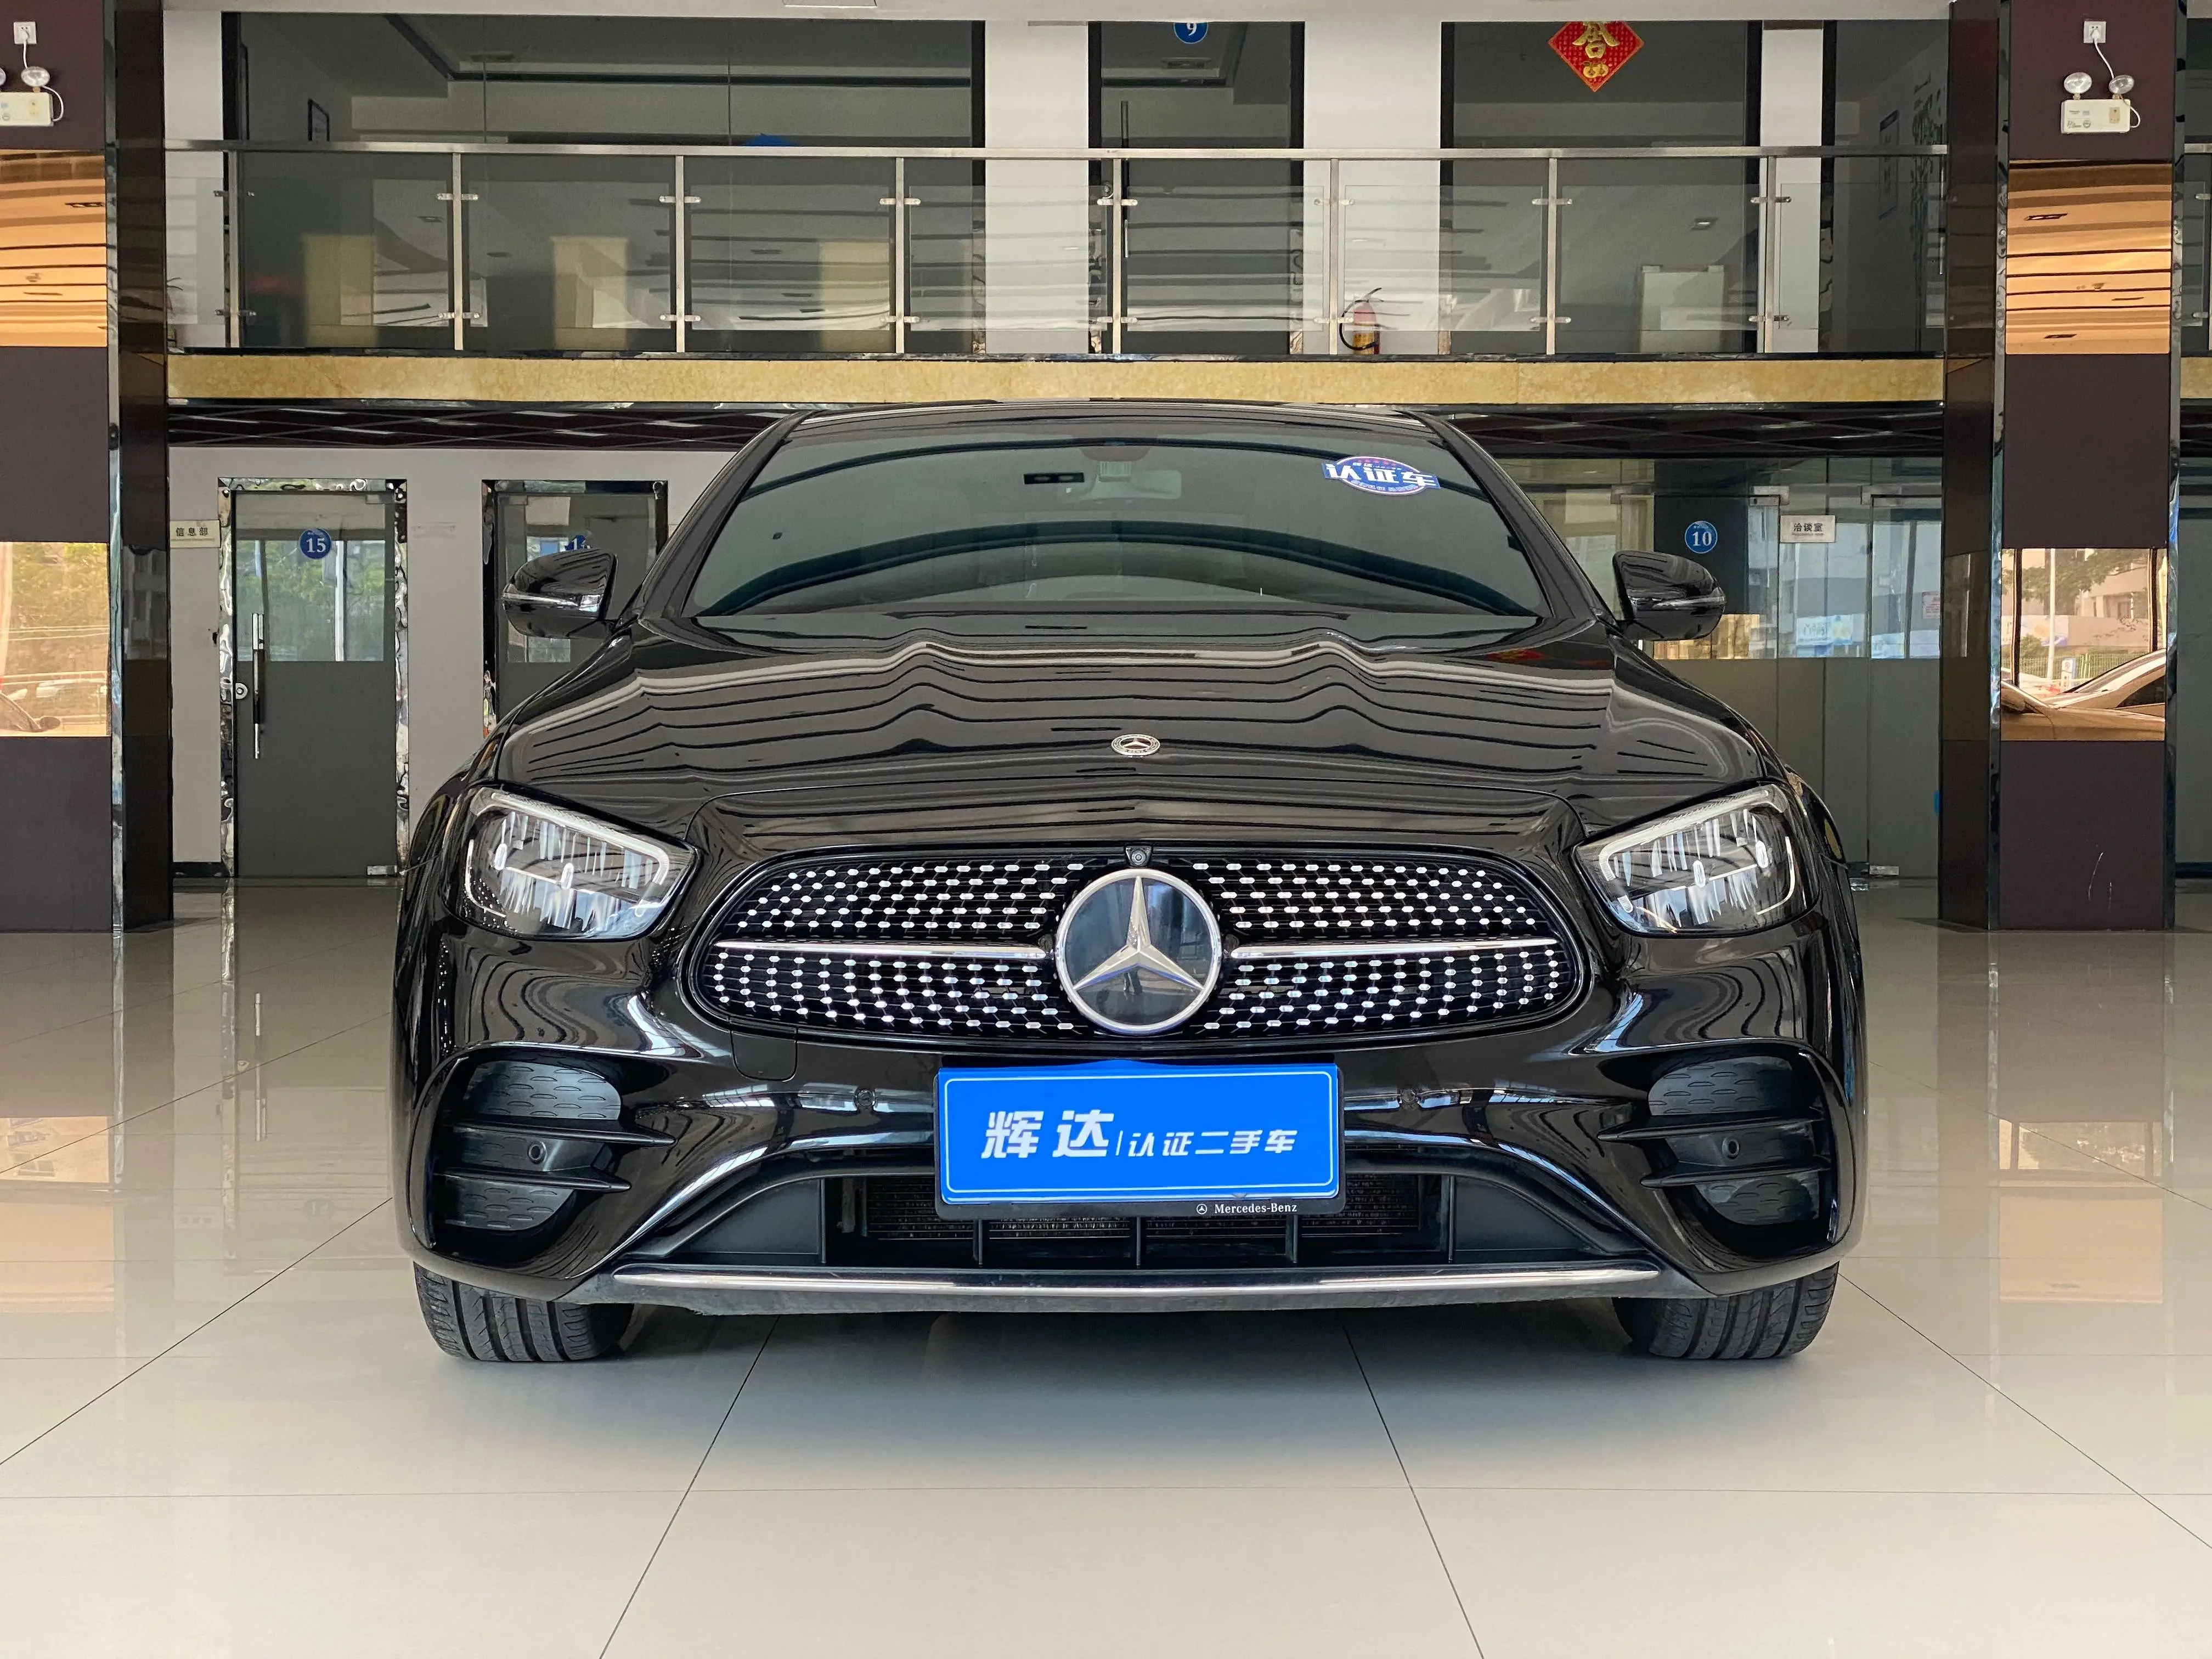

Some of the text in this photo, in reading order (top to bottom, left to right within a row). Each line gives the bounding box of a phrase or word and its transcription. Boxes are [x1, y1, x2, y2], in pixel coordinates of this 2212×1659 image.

[1325, 464, 1437, 487] 认证车
[176, 527, 208, 537] 信息部
[1793, 522, 1822, 532] 洽谈室
[306, 538, 326, 552] 15
[1692, 531, 1712, 546] 10
[981, 1109, 1297, 1159] 辉达 认证二手车
[1214, 1202, 1297, 1214] Mercedes-Benz
